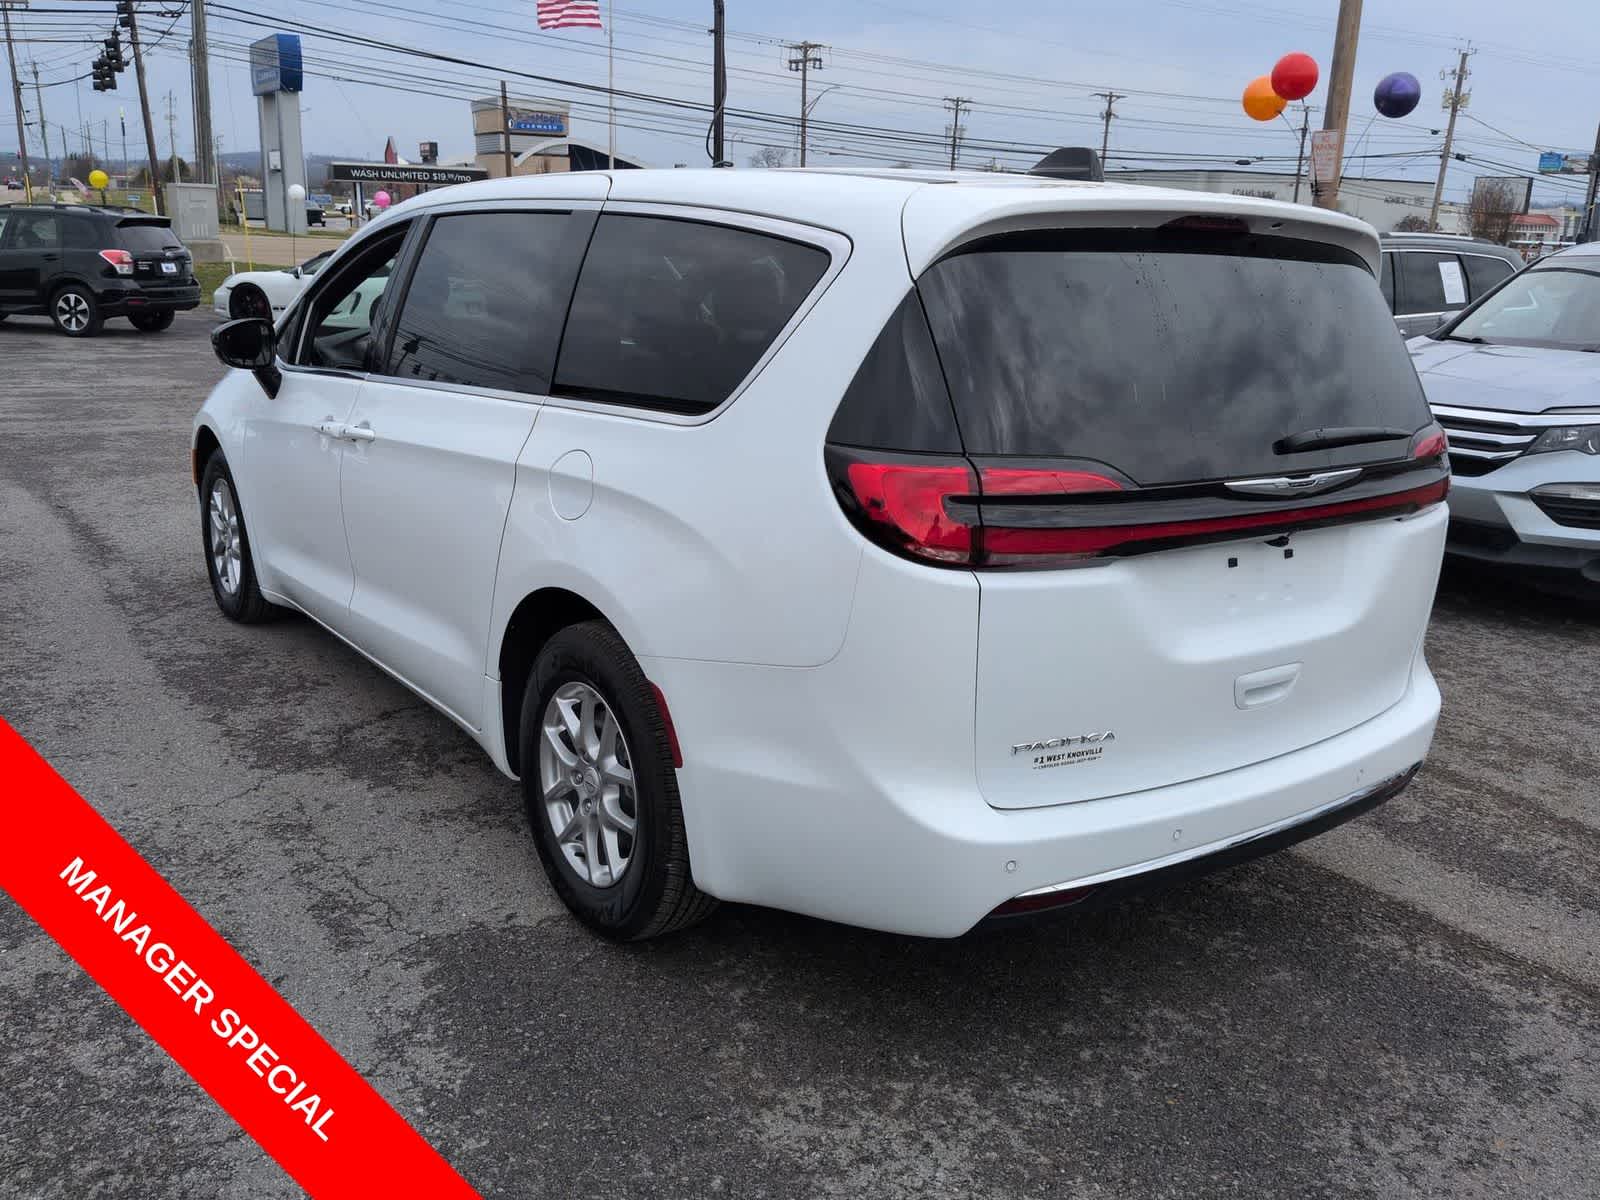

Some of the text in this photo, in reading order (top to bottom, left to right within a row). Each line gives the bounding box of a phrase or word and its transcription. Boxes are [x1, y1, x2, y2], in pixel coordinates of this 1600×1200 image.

[350, 169, 379, 179] WASH
[381, 171, 430, 181] UNLIMITED
[1011, 730, 1116, 755] PACIFICA
[1046, 753, 1066, 762] WEST
[1066, 747, 1103, 759] KNOXVILLE
